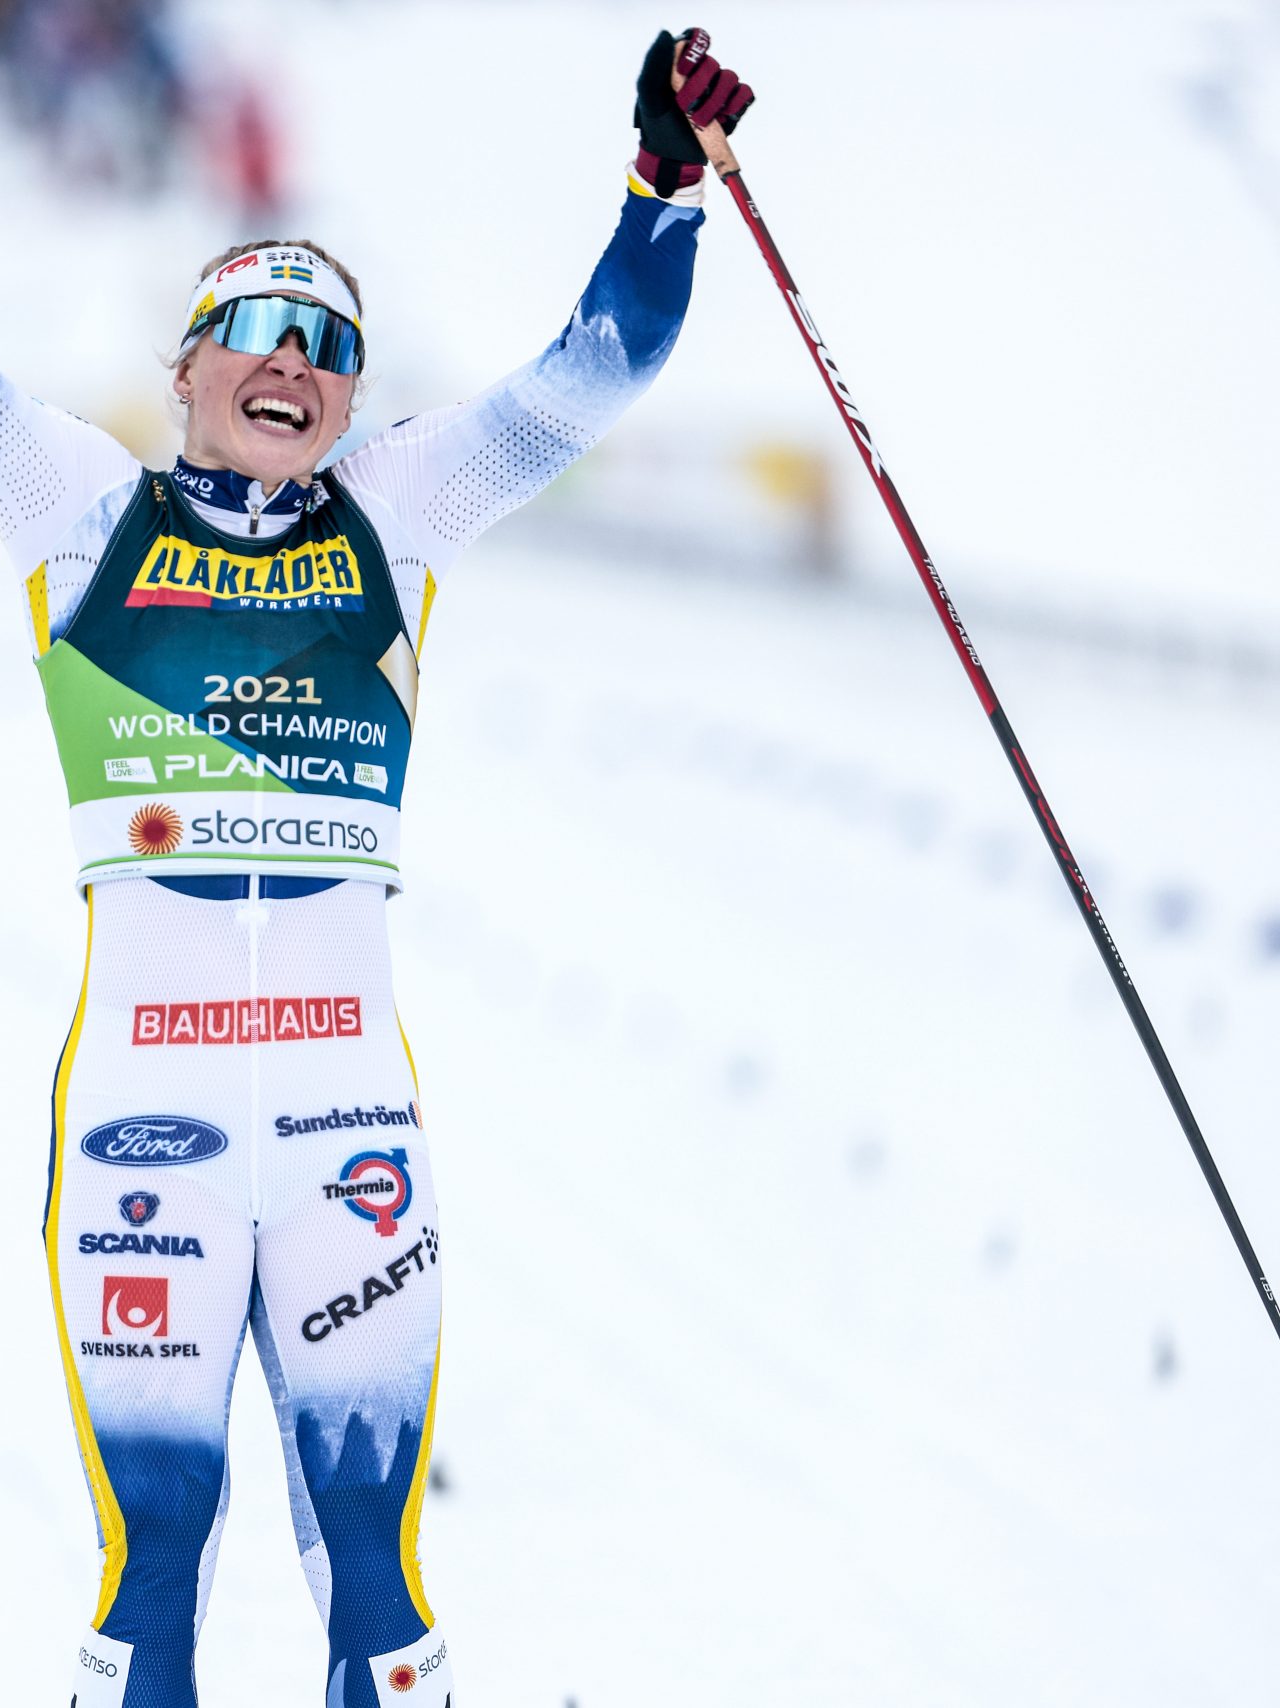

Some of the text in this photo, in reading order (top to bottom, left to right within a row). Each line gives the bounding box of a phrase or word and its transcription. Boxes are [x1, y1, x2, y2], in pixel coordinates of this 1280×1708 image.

[785, 288, 888, 481] SWIX
[923, 556, 950, 600] TRIAC
[204, 675, 323, 705] 2021
[108, 712, 387, 748] WORLD CHAMPION
[111, 760, 130, 768] FEEL
[164, 753, 349, 785] PLANICA
[361, 765, 374, 774] FEEL
[136, 1001, 359, 1041] BAUHAUS
[274, 1106, 410, 1138] Sundström
[106, 1123, 199, 1157] Ford
[322, 1177, 395, 1201] Thermia
[78, 1232, 205, 1259] SCANIA
[301, 1240, 425, 1343] CRAFT
[80, 1341, 201, 1359] SVENSKA SPEL
